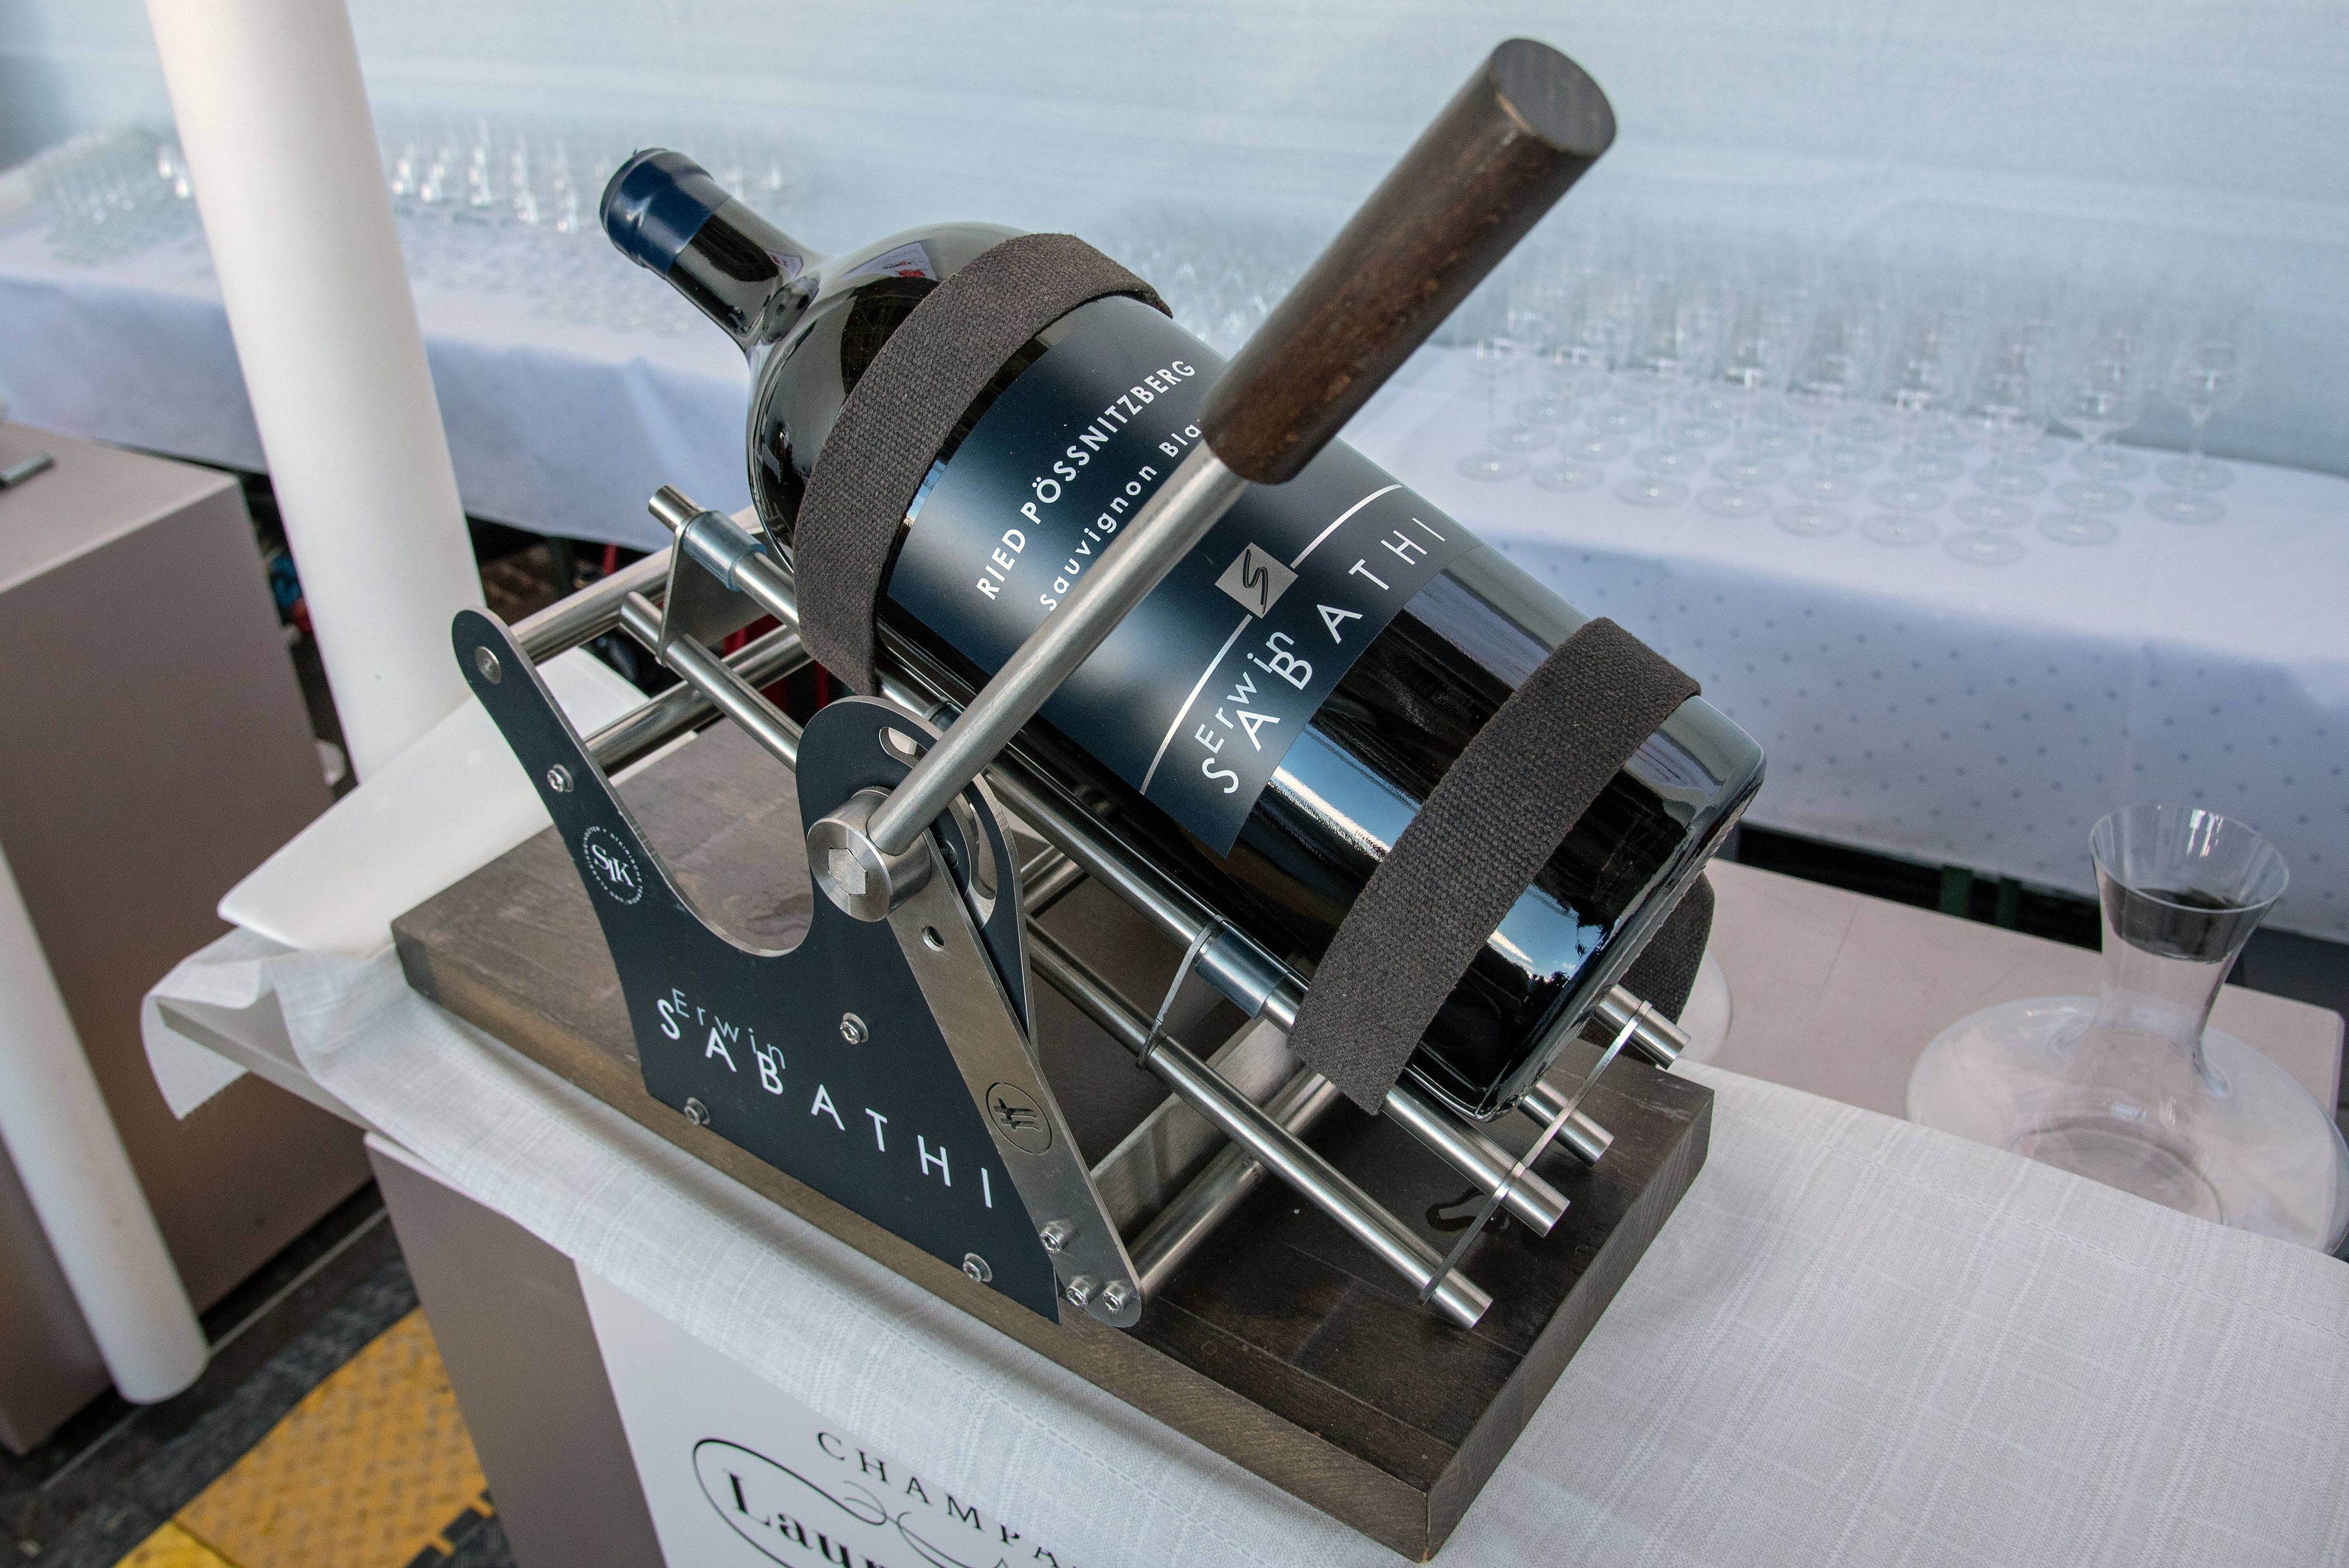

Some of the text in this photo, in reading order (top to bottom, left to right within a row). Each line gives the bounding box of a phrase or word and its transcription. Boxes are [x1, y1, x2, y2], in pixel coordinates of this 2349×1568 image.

[976, 359, 1196, 601] RIED PÖSSNITZBERG
[1039, 419, 1202, 611] Sauvignon Bla
[1194, 630, 1295, 754] Erwin
[1202, 517, 1446, 793] SABATHI
[657, 998, 992, 1209] SABATHI
[671, 988, 786, 1070] Erwin
